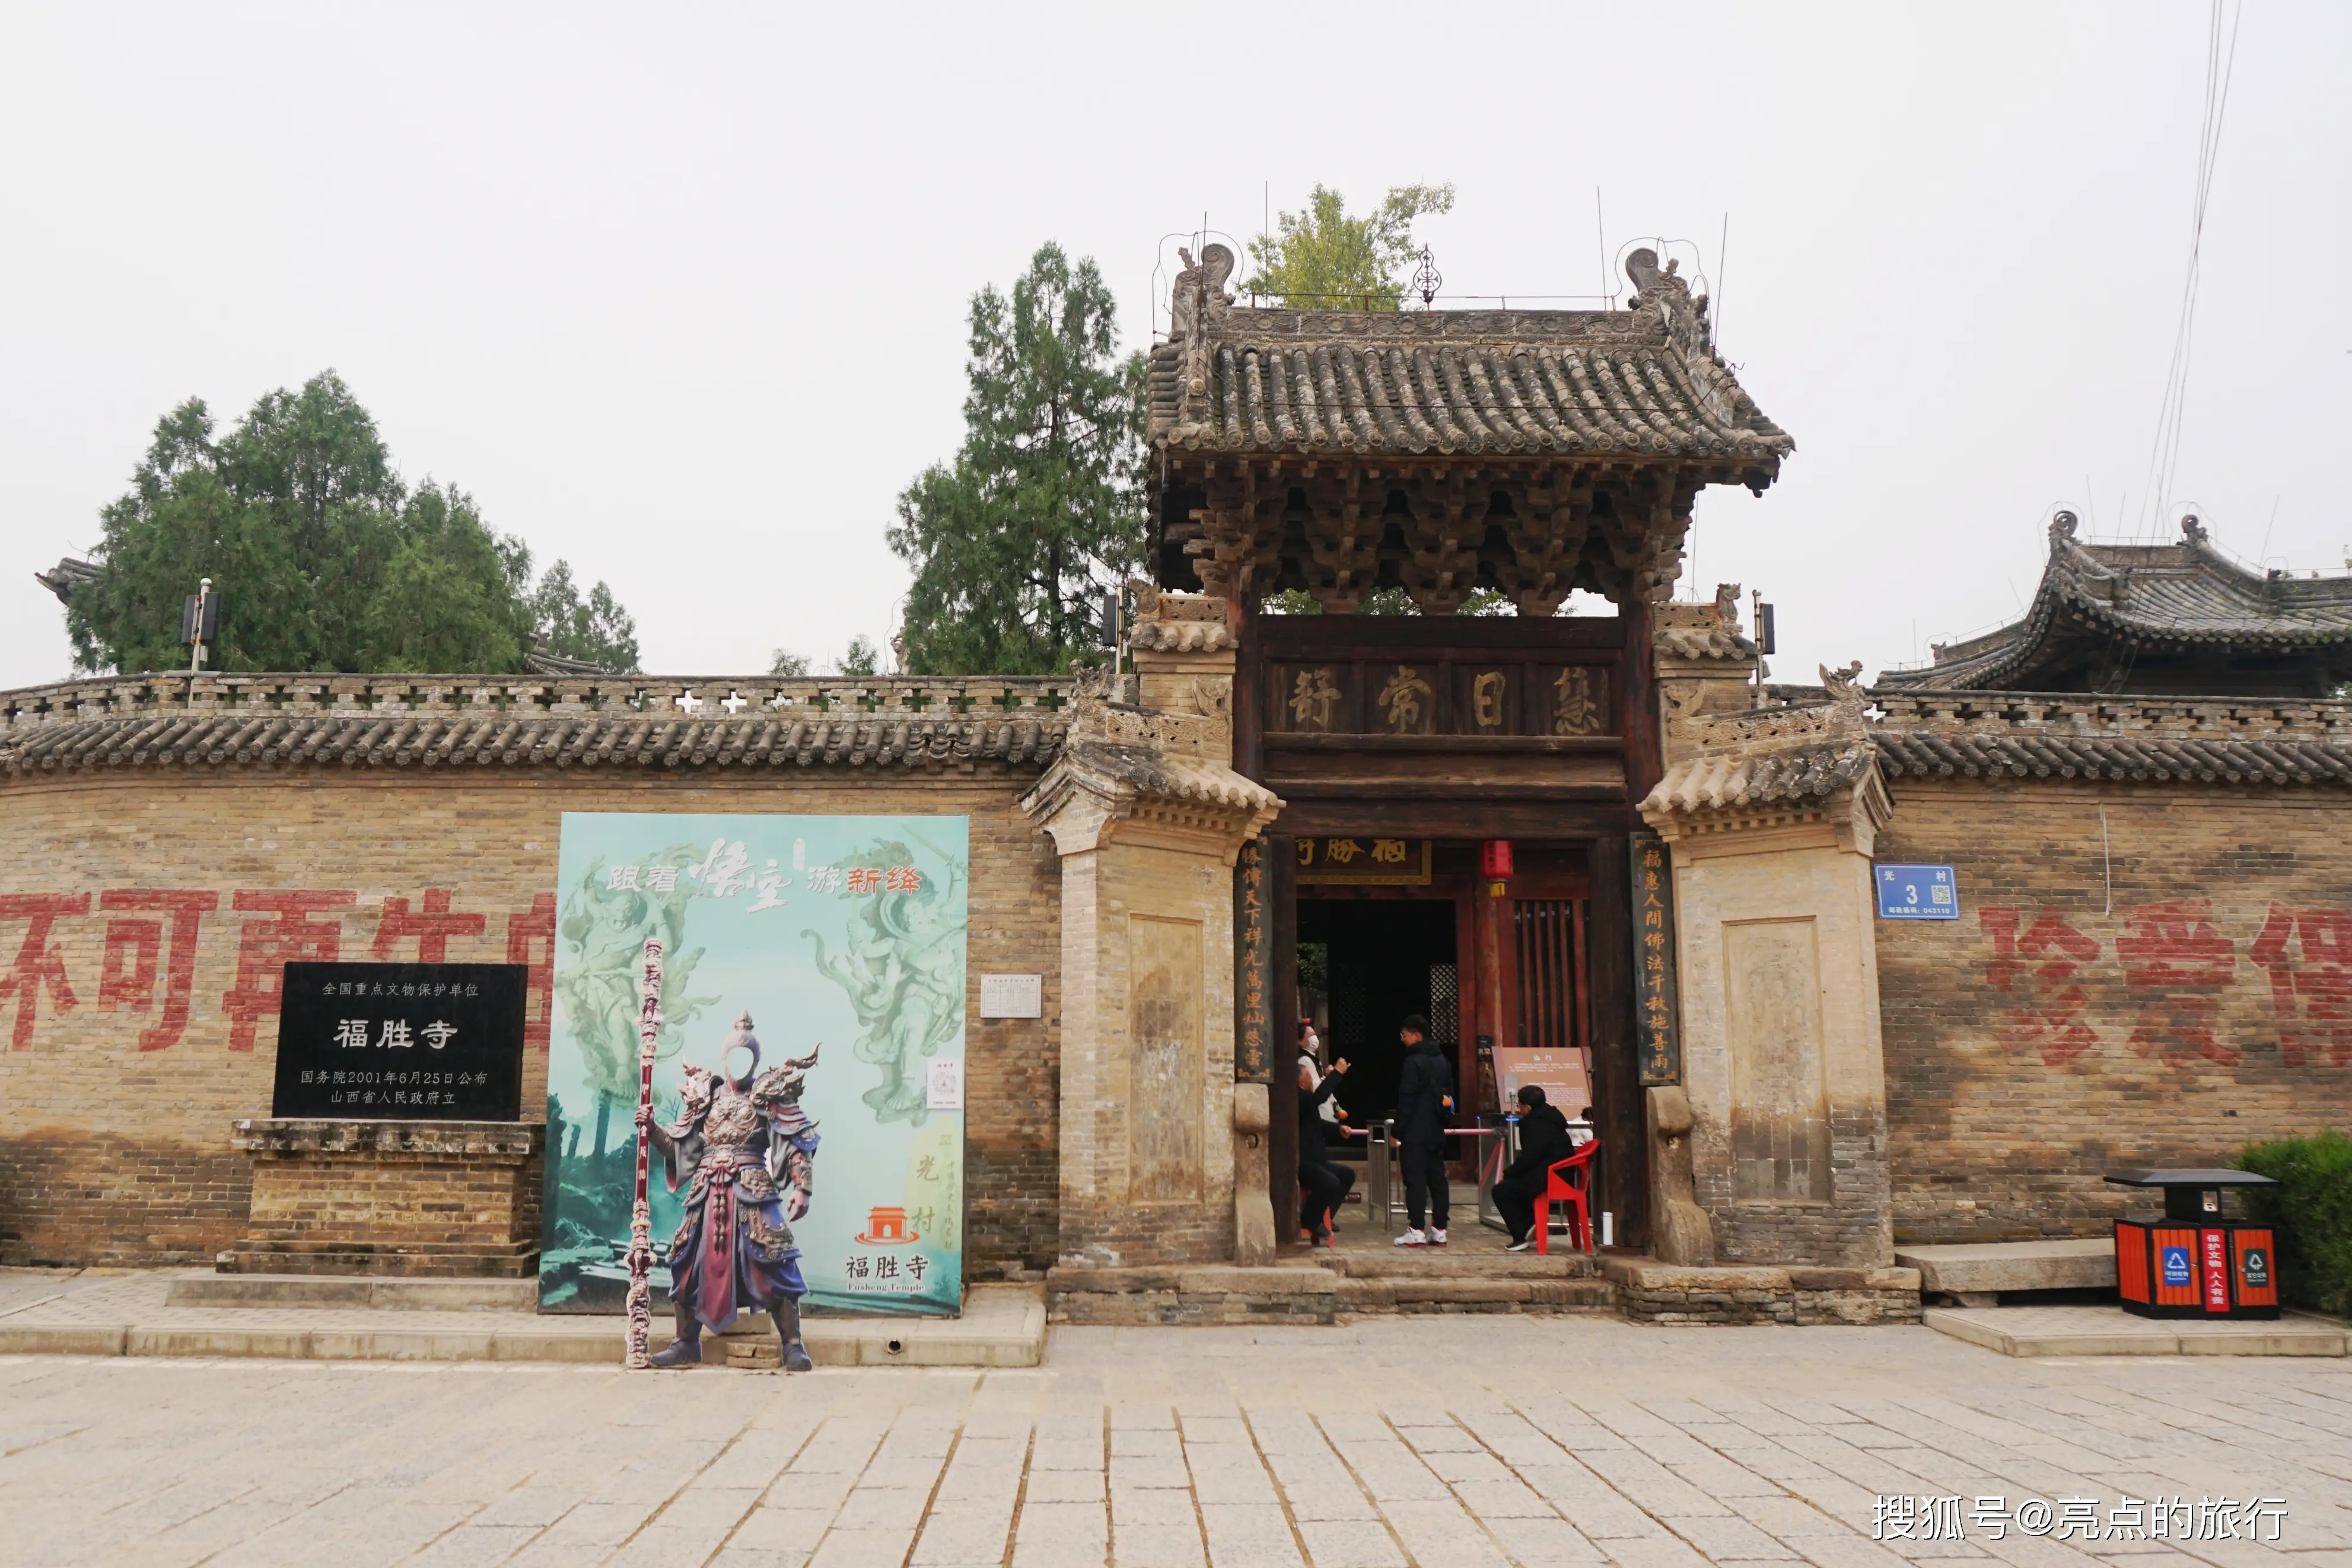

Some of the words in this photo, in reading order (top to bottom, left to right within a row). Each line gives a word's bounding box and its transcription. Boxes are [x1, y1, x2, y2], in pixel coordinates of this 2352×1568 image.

[1905, 884, 1918, 904] 3
[322, 982, 479, 997] 全国重点文物保护单位
[333, 1018, 459, 1049] 福胜寺
[301, 1070, 488, 1085] 国务院2001年6月25日公布
[331, 1090, 456, 1104] 山西省人民政府立
[912, 1155, 939, 1234] 光村
[2206, 1234, 2222, 1268] 保护文物
[846, 1255, 928, 1280] 福胜寺
[848, 1283, 887, 1292] Fusheng
[889, 1283, 924, 1292] Temple
[2209, 1271, 2224, 1305] 人人有责
